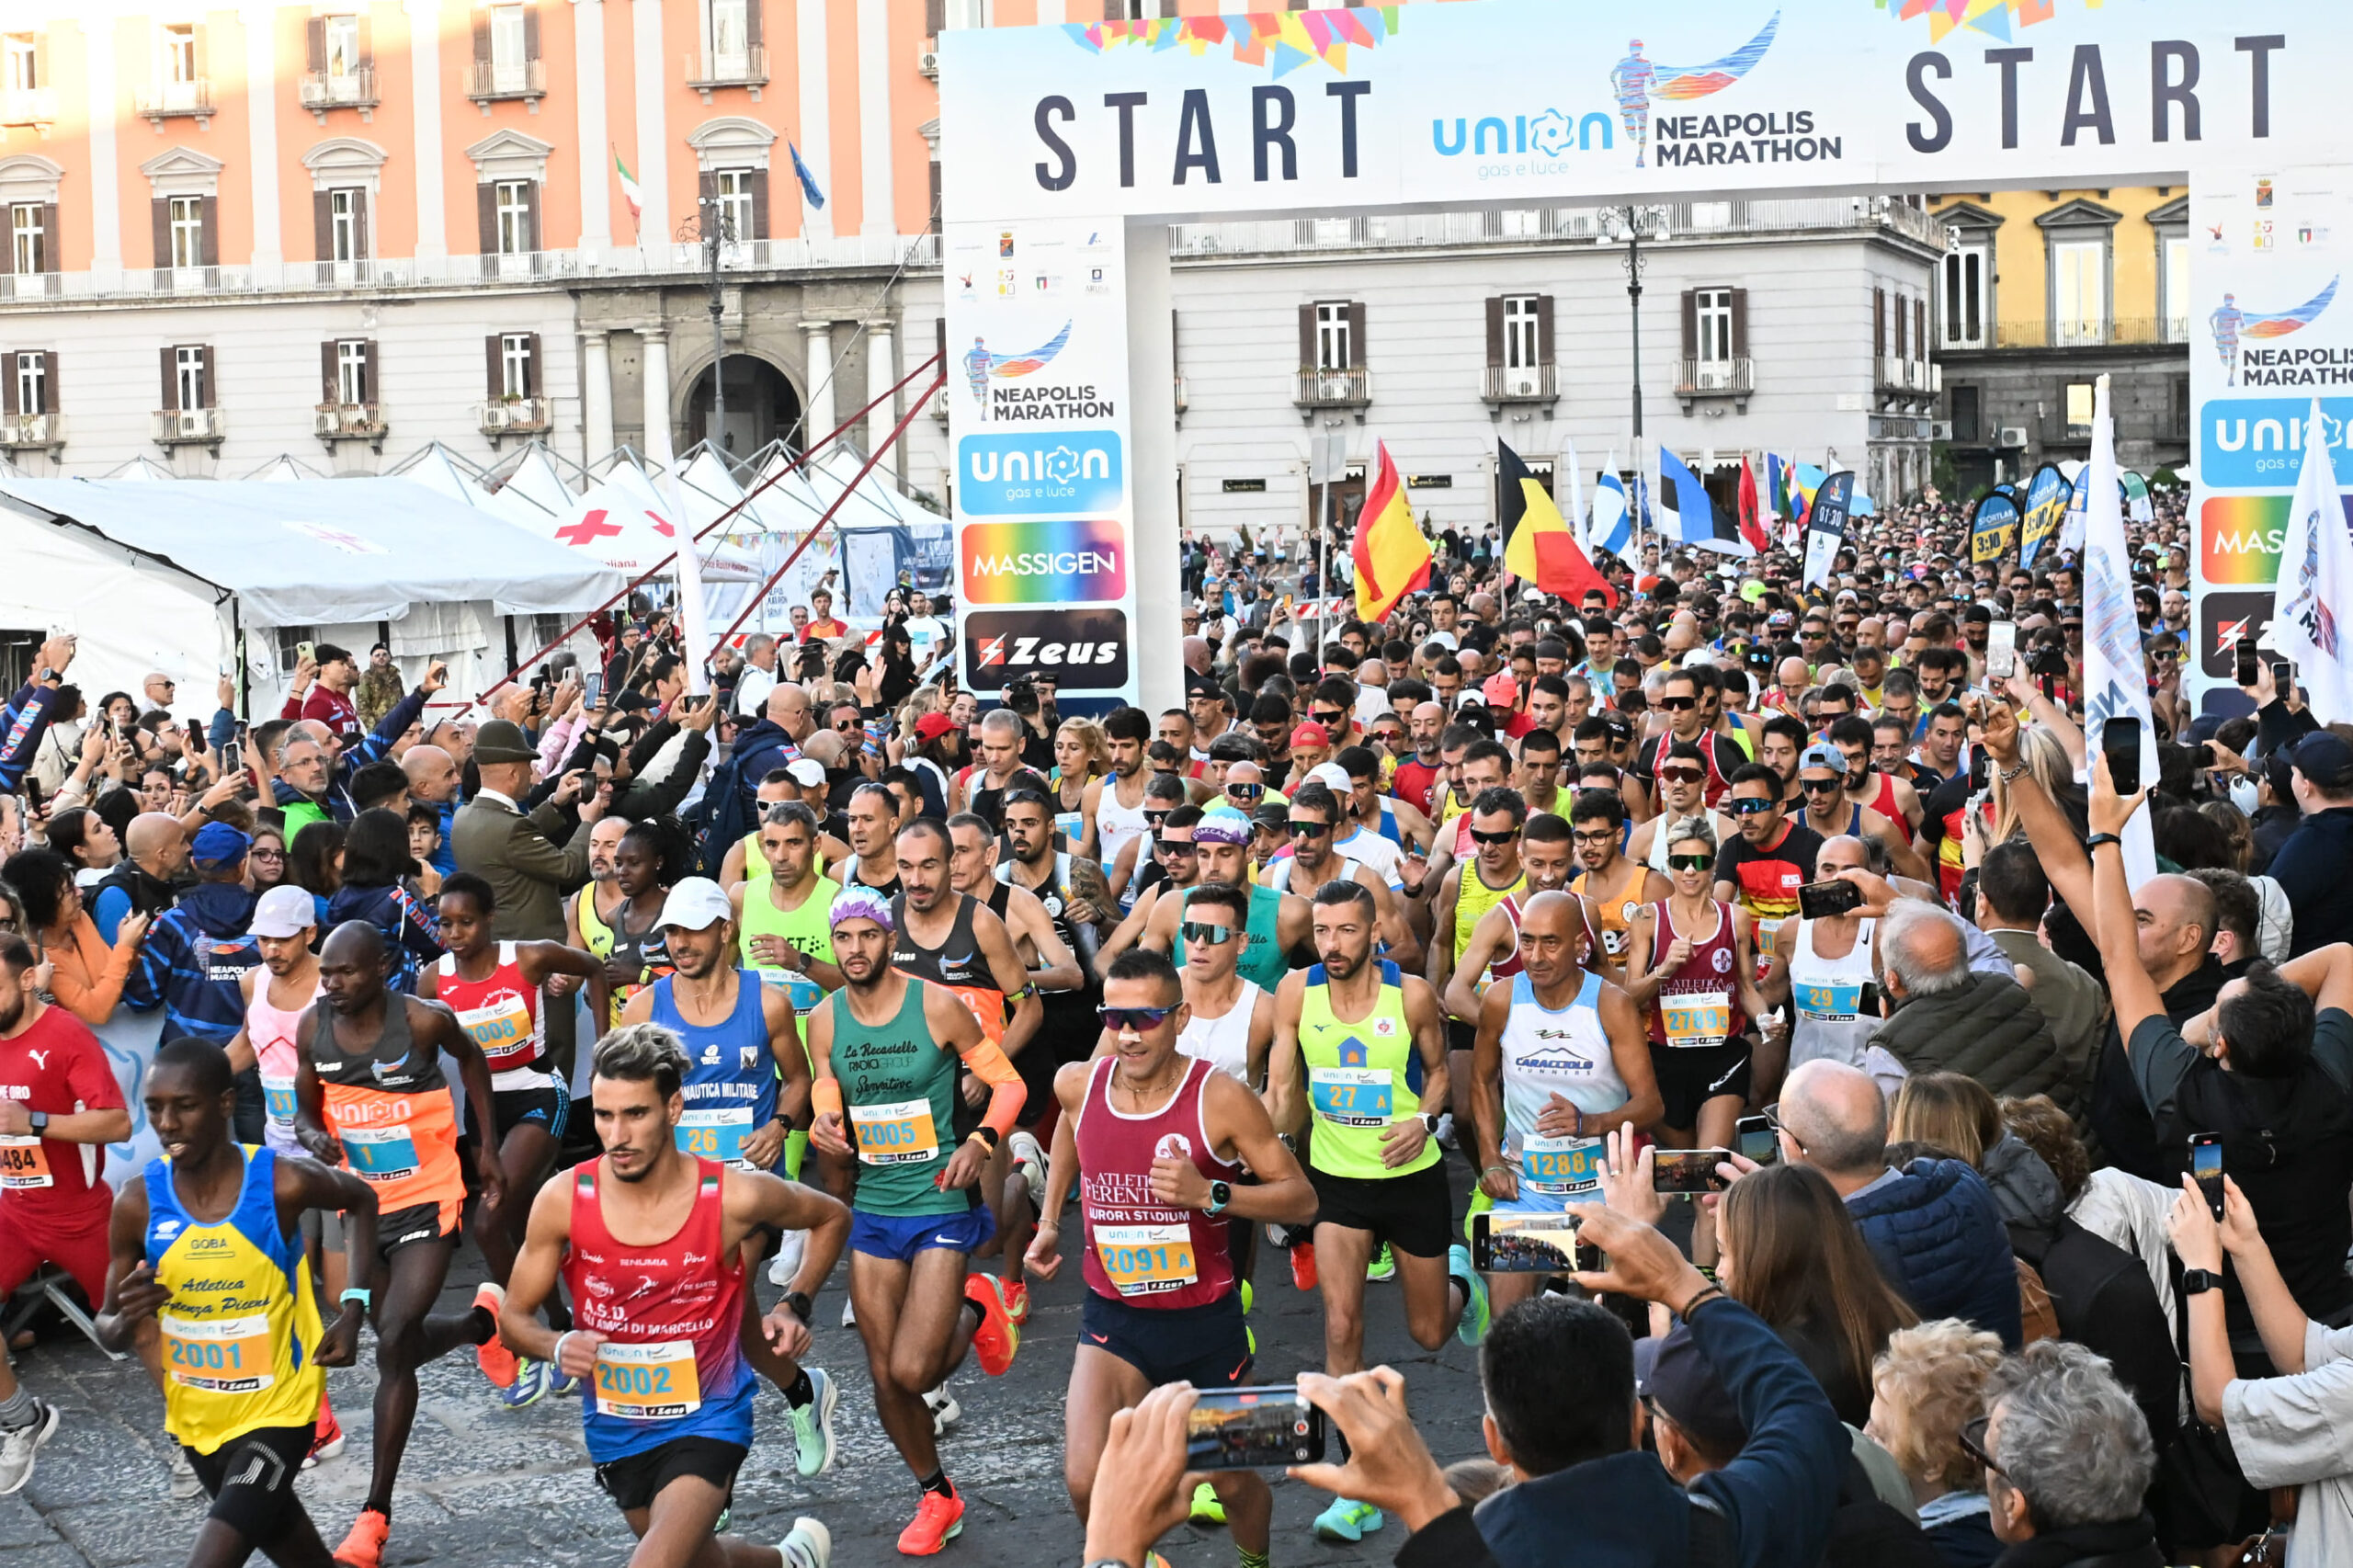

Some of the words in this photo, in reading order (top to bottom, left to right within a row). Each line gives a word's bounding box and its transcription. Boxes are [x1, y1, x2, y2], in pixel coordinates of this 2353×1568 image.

[1905, 34, 2286, 153] START
[1655, 110, 1814, 140] NEAPOLIS
[1034, 80, 1370, 191] START
[1656, 136, 1842, 166] MARATHON
[1477, 164, 1511, 180] gas
[1515, 163, 1527, 176] e
[1530, 159, 1569, 176] luce
[2243, 368, 2353, 387] MARATH
[994, 385, 1097, 403] NEAPOLIS
[994, 402, 1114, 421] MARATHON
[2256, 459, 2288, 472] gas
[1006, 487, 1031, 501] gas
[1035, 486, 1042, 497] e
[1046, 484, 1075, 497] luce
[1978, 509, 2014, 526] SPORTLAB
[1976, 532, 2001, 552] 3:10
[972, 551, 1116, 576] MASSIGEN
[1007, 637, 1119, 665] Zeus
[1809, 988, 1834, 1006] 29
[1668, 1009, 1718, 1030] 2789
[1515, 1056, 1594, 1070] CARACCIOLO
[1518, 1067, 1591, 1076] RUNNERS
[681, 1083, 721, 1102] NAUTICA
[722, 1083, 759, 1100] MILITARE
[1329, 1085, 1358, 1108] 27
[1376, 1095, 1387, 1108] A
[688, 1129, 718, 1152] 26
[858, 1120, 916, 1146] 2005
[361, 1145, 373, 1165] 1
[1528, 1152, 1586, 1176] 1288
[1096, 1172, 1152, 1187] ATLETI
[1133, 1210, 1190, 1221] STADIUM
[190, 1238, 228, 1250] GOBA
[1103, 1246, 1168, 1273] 2091
[1178, 1253, 1190, 1268] A
[179, 1278, 246, 1292] Atletica
[1157, 1279, 1185, 1290] Zeus
[162, 1301, 214, 1318] otenza
[584, 1298, 630, 1322] A.S.D.
[631, 1322, 645, 1334] DI
[647, 1317, 714, 1335] MARCELLO
[169, 1339, 243, 1369] 2001
[598, 1363, 674, 1395] 2002
[656, 1405, 687, 1415] Zeus
